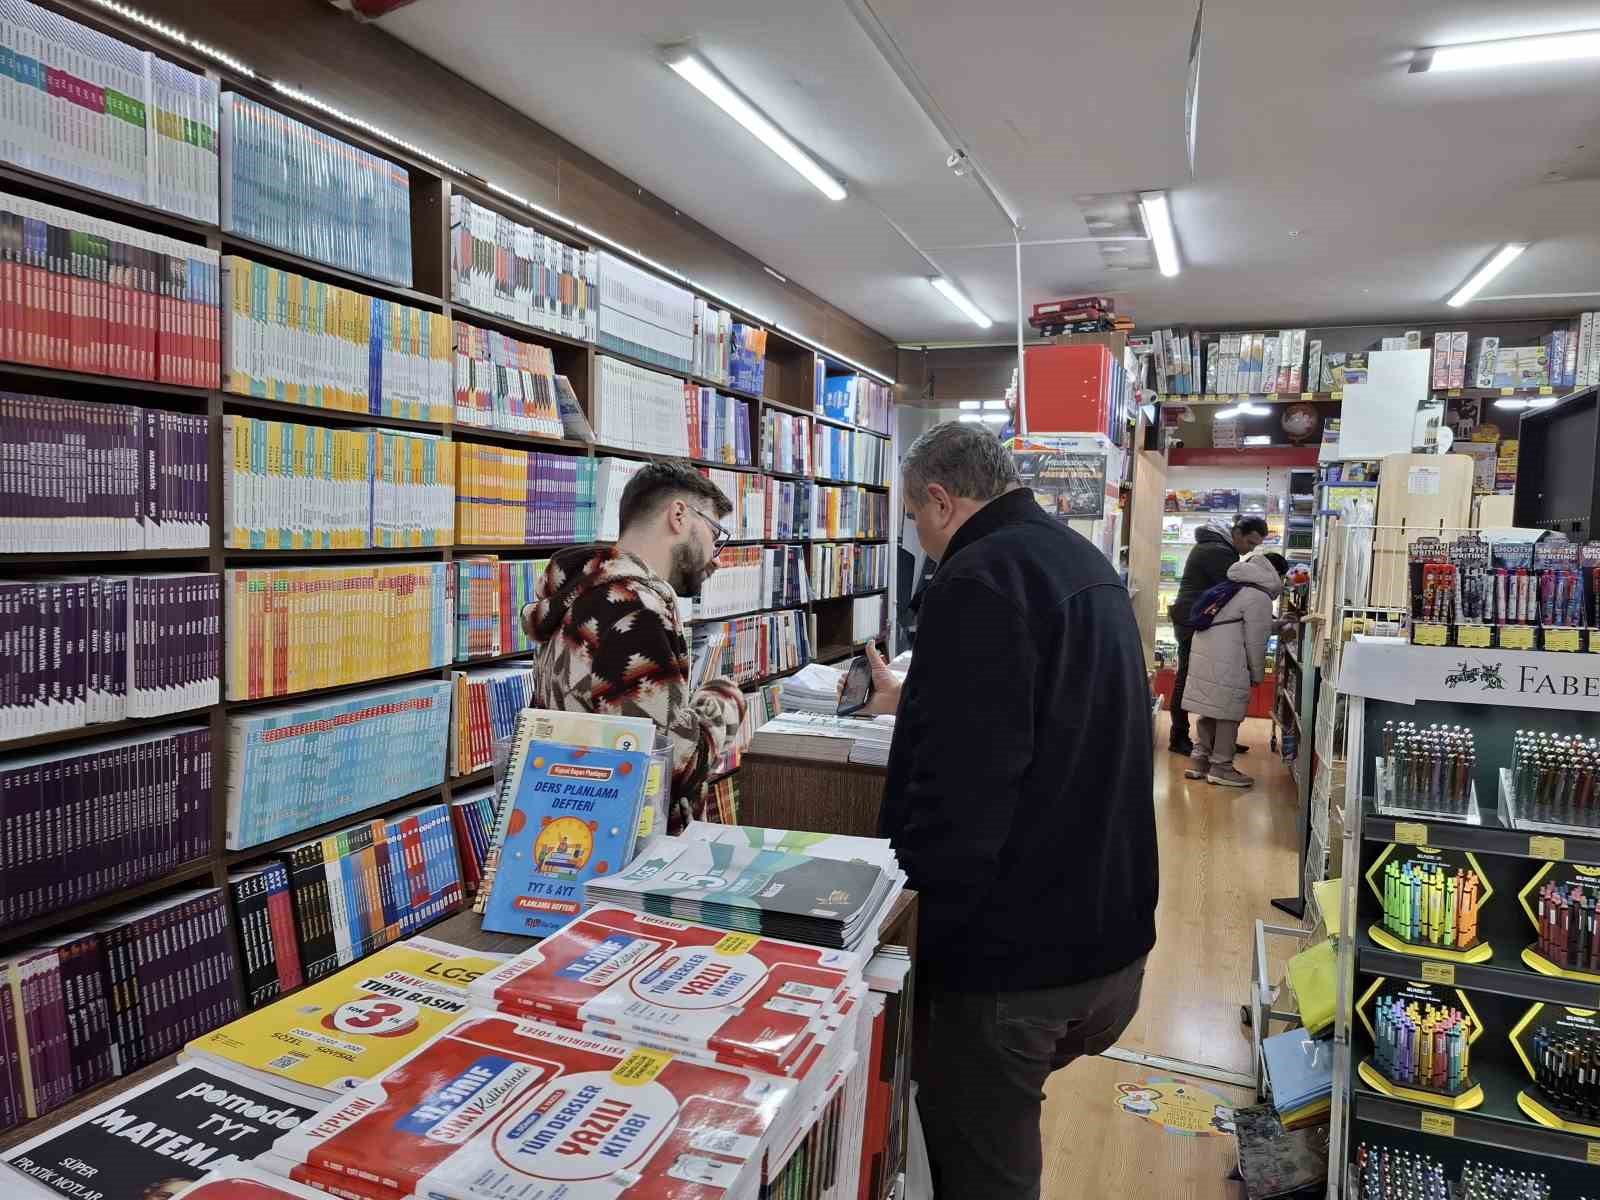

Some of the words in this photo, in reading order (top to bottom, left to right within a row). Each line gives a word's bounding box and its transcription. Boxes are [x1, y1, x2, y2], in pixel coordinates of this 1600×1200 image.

[39, 627, 47, 671] MATEMATİK
[53, 626, 61, 669] MATEMATİK
[1519, 665, 1600, 697] FABE
[534, 781, 562, 794] DERS
[563, 785, 619, 799] PLANLAMA
[551, 797, 595, 812] DEFTERİ
[528, 881, 546, 894] TYT
[555, 884, 576, 897] AYT
[424, 962, 485, 982] LGS
[670, 953, 706, 982] DERSLER
[677, 962, 732, 997] YAZILI
[361, 979, 407, 997] TIPKI
[405, 992, 465, 1013] BASIM
[711, 972, 747, 999] KİTABI
[345, 1003, 402, 1028] 3
[305, 1096, 378, 1139] YEPYENİ
[432, 1104, 484, 1139] SINAV
[475, 1066, 530, 1110] Kalitesinde
[197, 1113, 259, 1141] TYT
[518, 1126, 552, 1156] TÜM
[546, 1084, 603, 1133] DERSLER
[554, 1098, 633, 1157] YAZILI
[599, 1112, 651, 1159] KİTABI
[13, 1157, 57, 1182] PRATİK
[51, 1176, 104, 1200] NOTLAR
[58, 1157, 99, 1179] SÜPER
